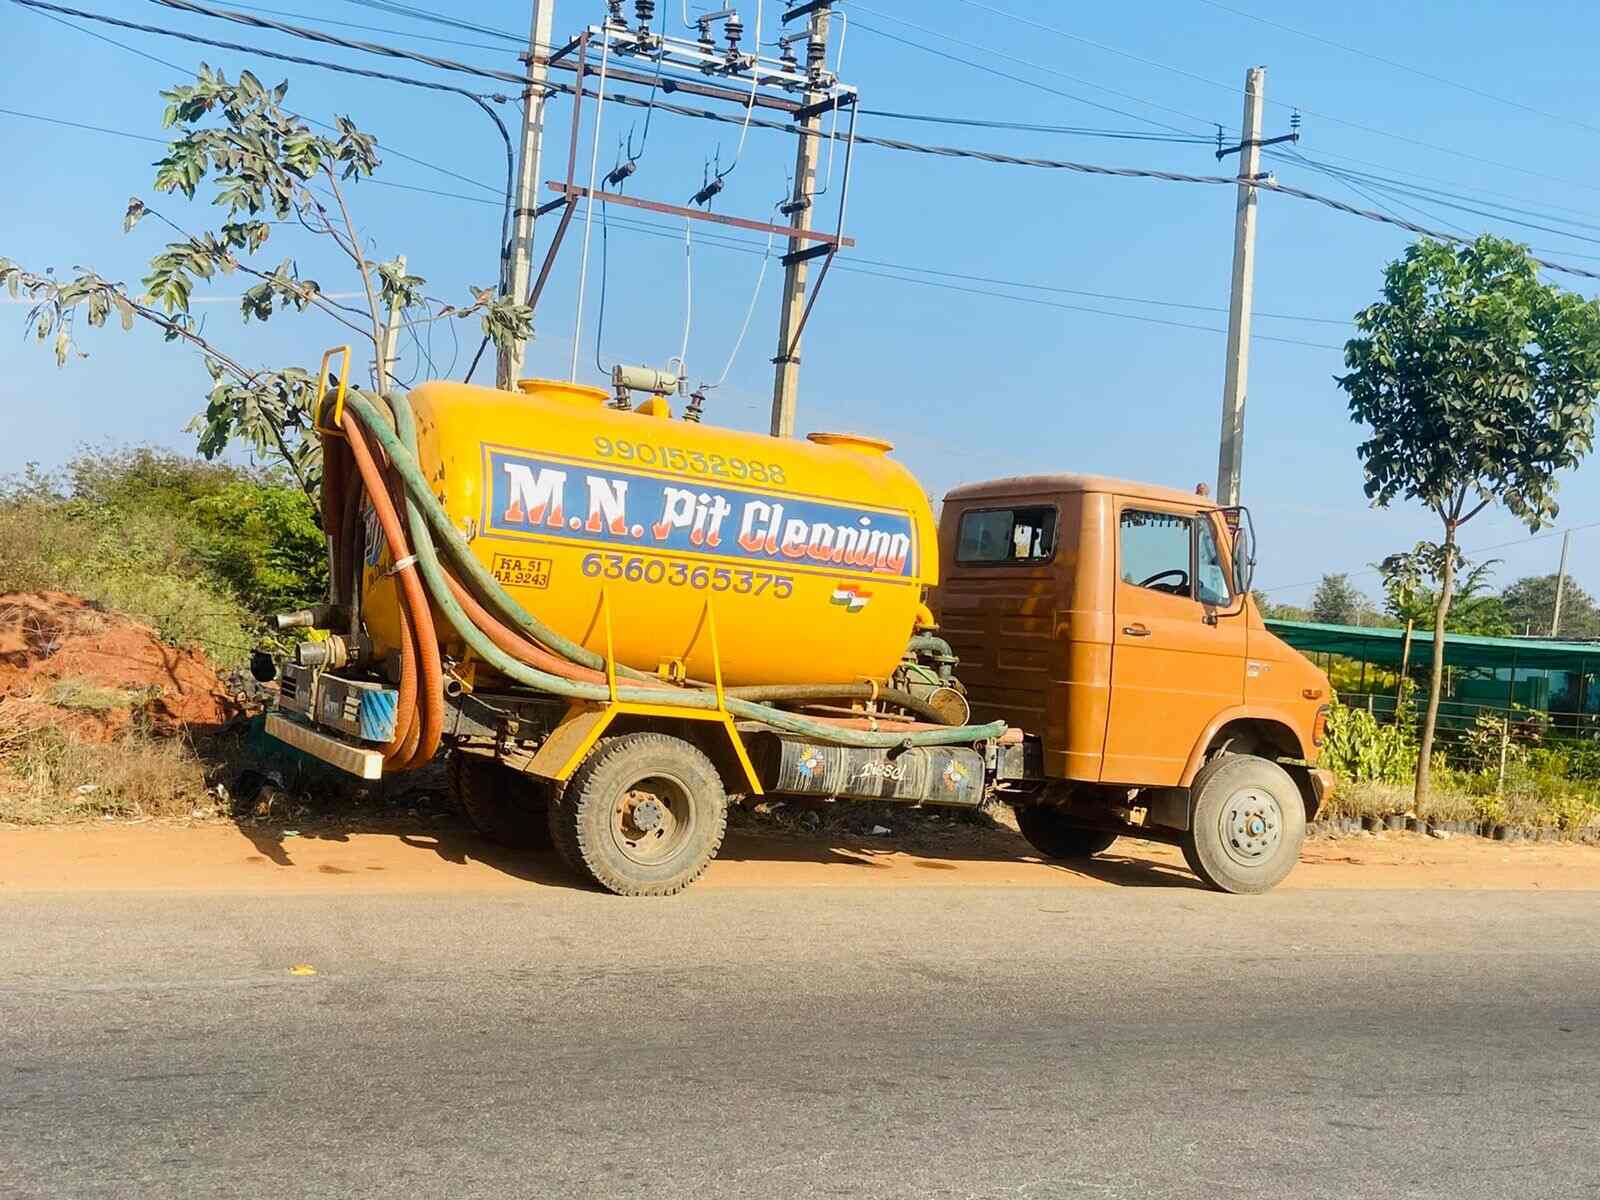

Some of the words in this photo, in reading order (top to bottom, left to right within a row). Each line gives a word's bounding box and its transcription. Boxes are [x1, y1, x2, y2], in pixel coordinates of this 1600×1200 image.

[593, 434, 787, 485] 9901532988
[502, 461, 645, 540] M.N.
[651, 485, 733, 548] Pit
[737, 499, 911, 577] Cleaning
[581, 551, 795, 600] 6360365375
